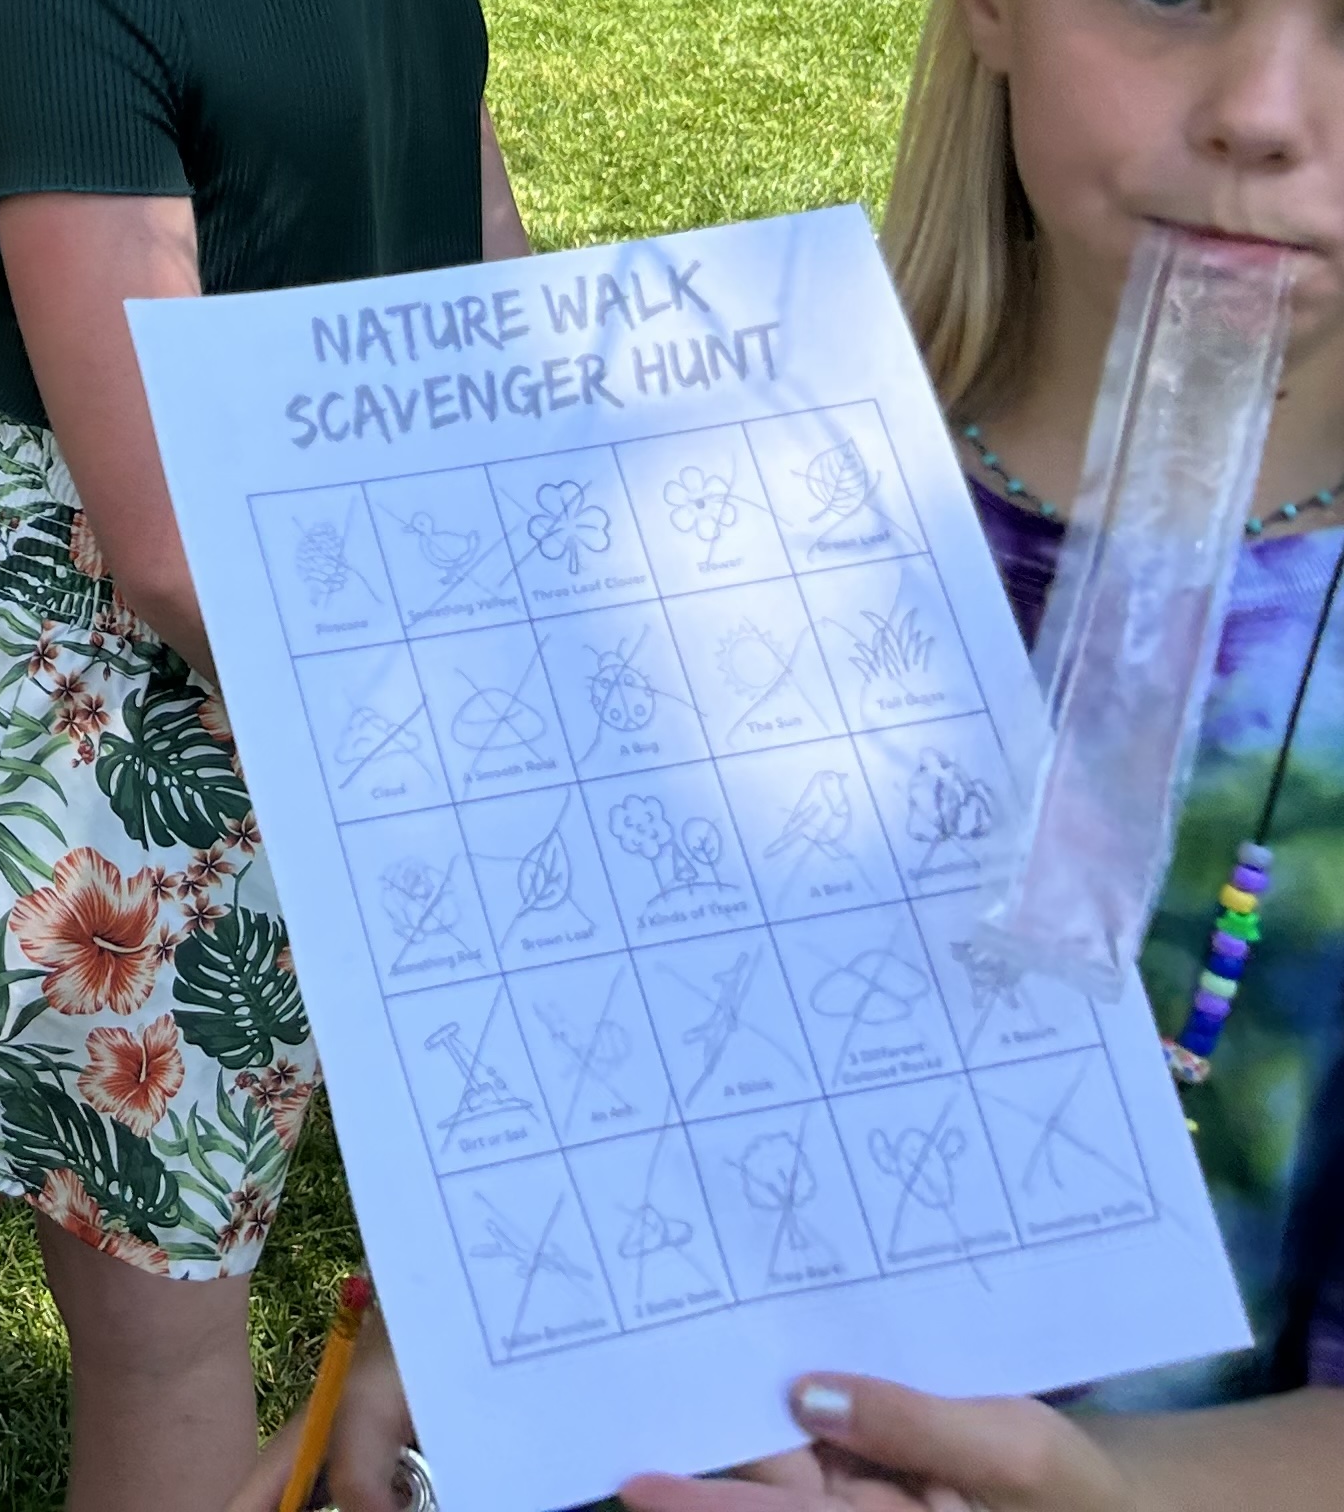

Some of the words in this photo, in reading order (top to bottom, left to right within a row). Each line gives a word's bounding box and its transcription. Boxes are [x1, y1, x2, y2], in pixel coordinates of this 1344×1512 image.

[310, 288, 530, 367] NATURE
[540, 258, 711, 335] WALK
[284, 352, 625, 451] SCAVENGER
[632, 320, 782, 395] HUNT
[696, 556, 745, 573] Flower
[531, 586, 571, 602] Three
[572, 580, 604, 595] Leaf
[605, 573, 647, 590] Clover
[875, 696, 903, 711] Tall
[745, 720, 774, 735] The
[775, 715, 803, 730] Sun
[371, 783, 406, 799] Cloud
[647, 909, 689, 927] Kinds
[690, 903, 705, 919] of
